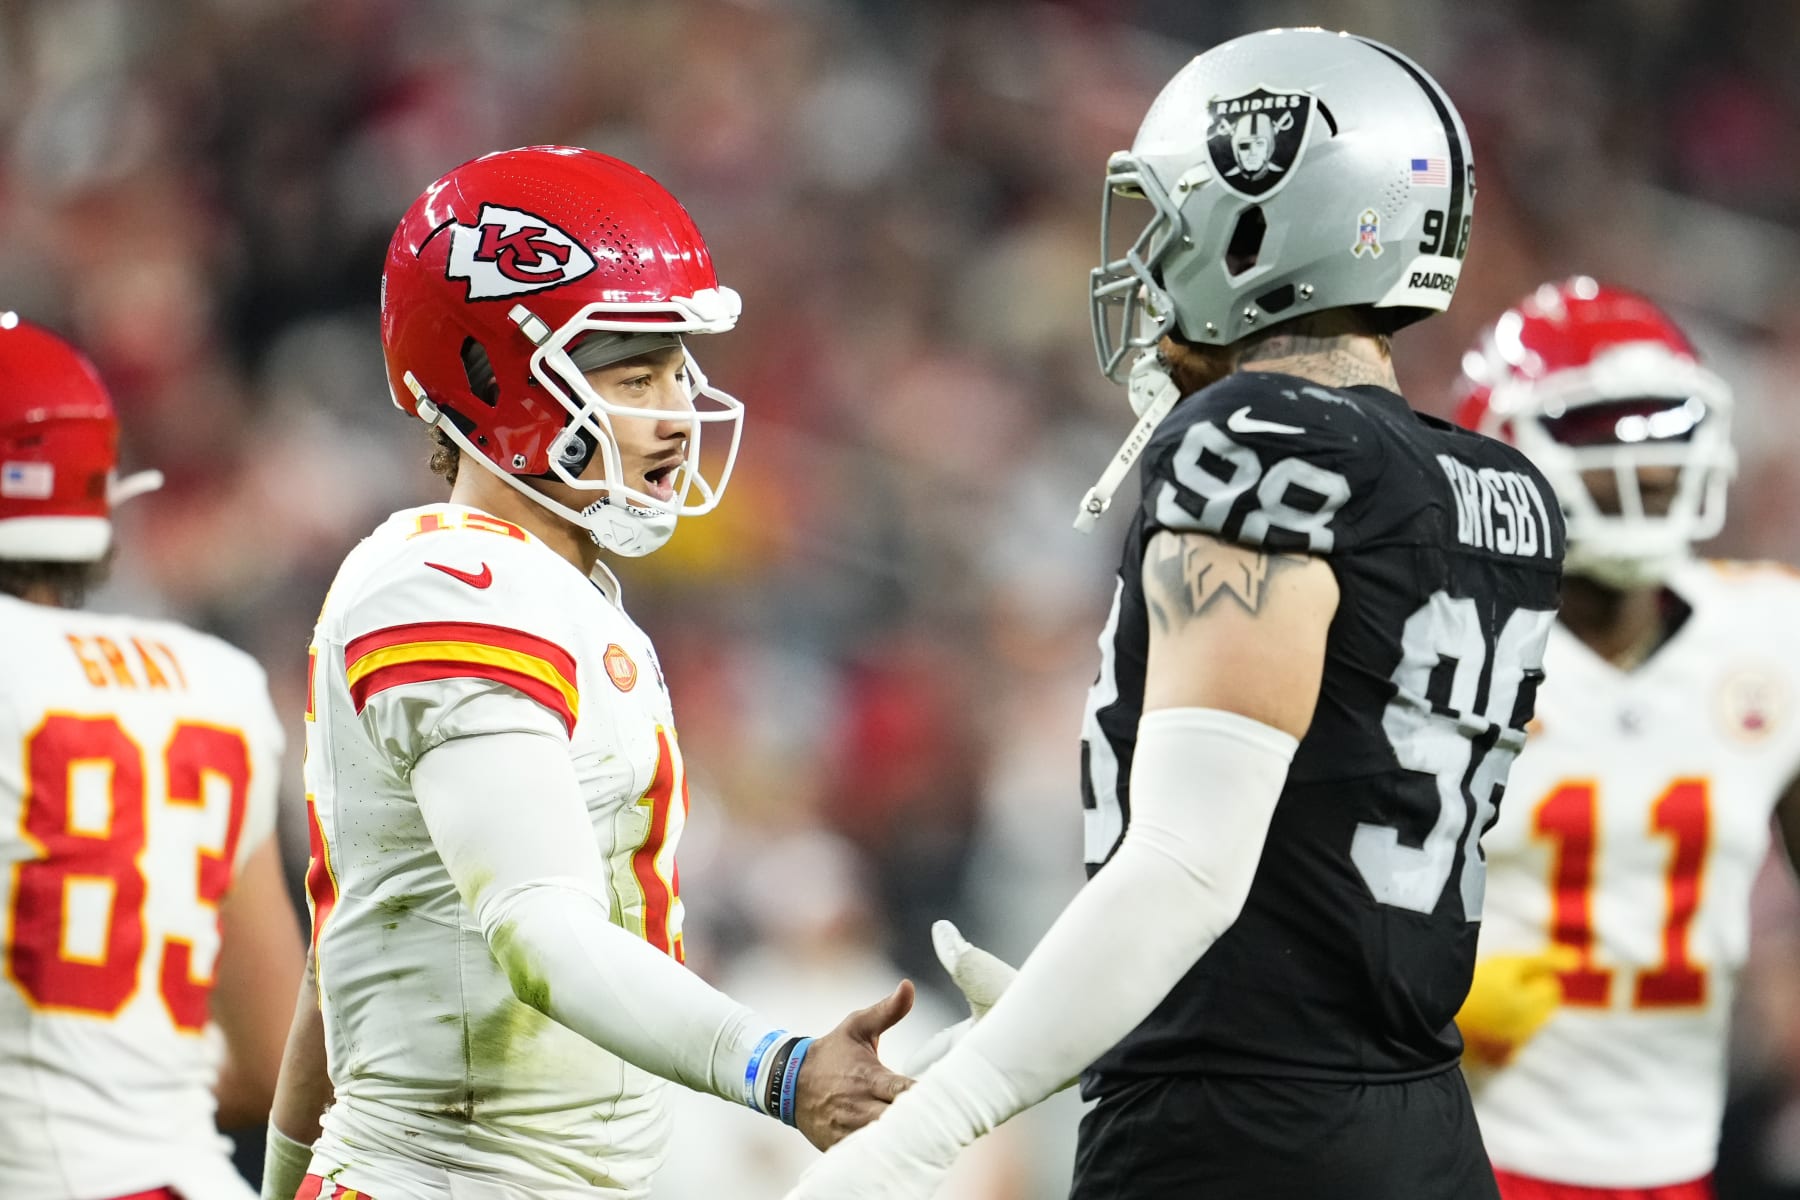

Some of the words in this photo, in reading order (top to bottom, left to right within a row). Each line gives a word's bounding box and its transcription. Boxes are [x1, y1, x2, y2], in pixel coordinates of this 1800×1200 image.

[1216, 95, 1301, 115] RAIDERS
[473, 224, 571, 284] KC
[1156, 421, 1351, 554] 98
[4, 710, 253, 1037] 83
[1529, 772, 1713, 1012] 11
